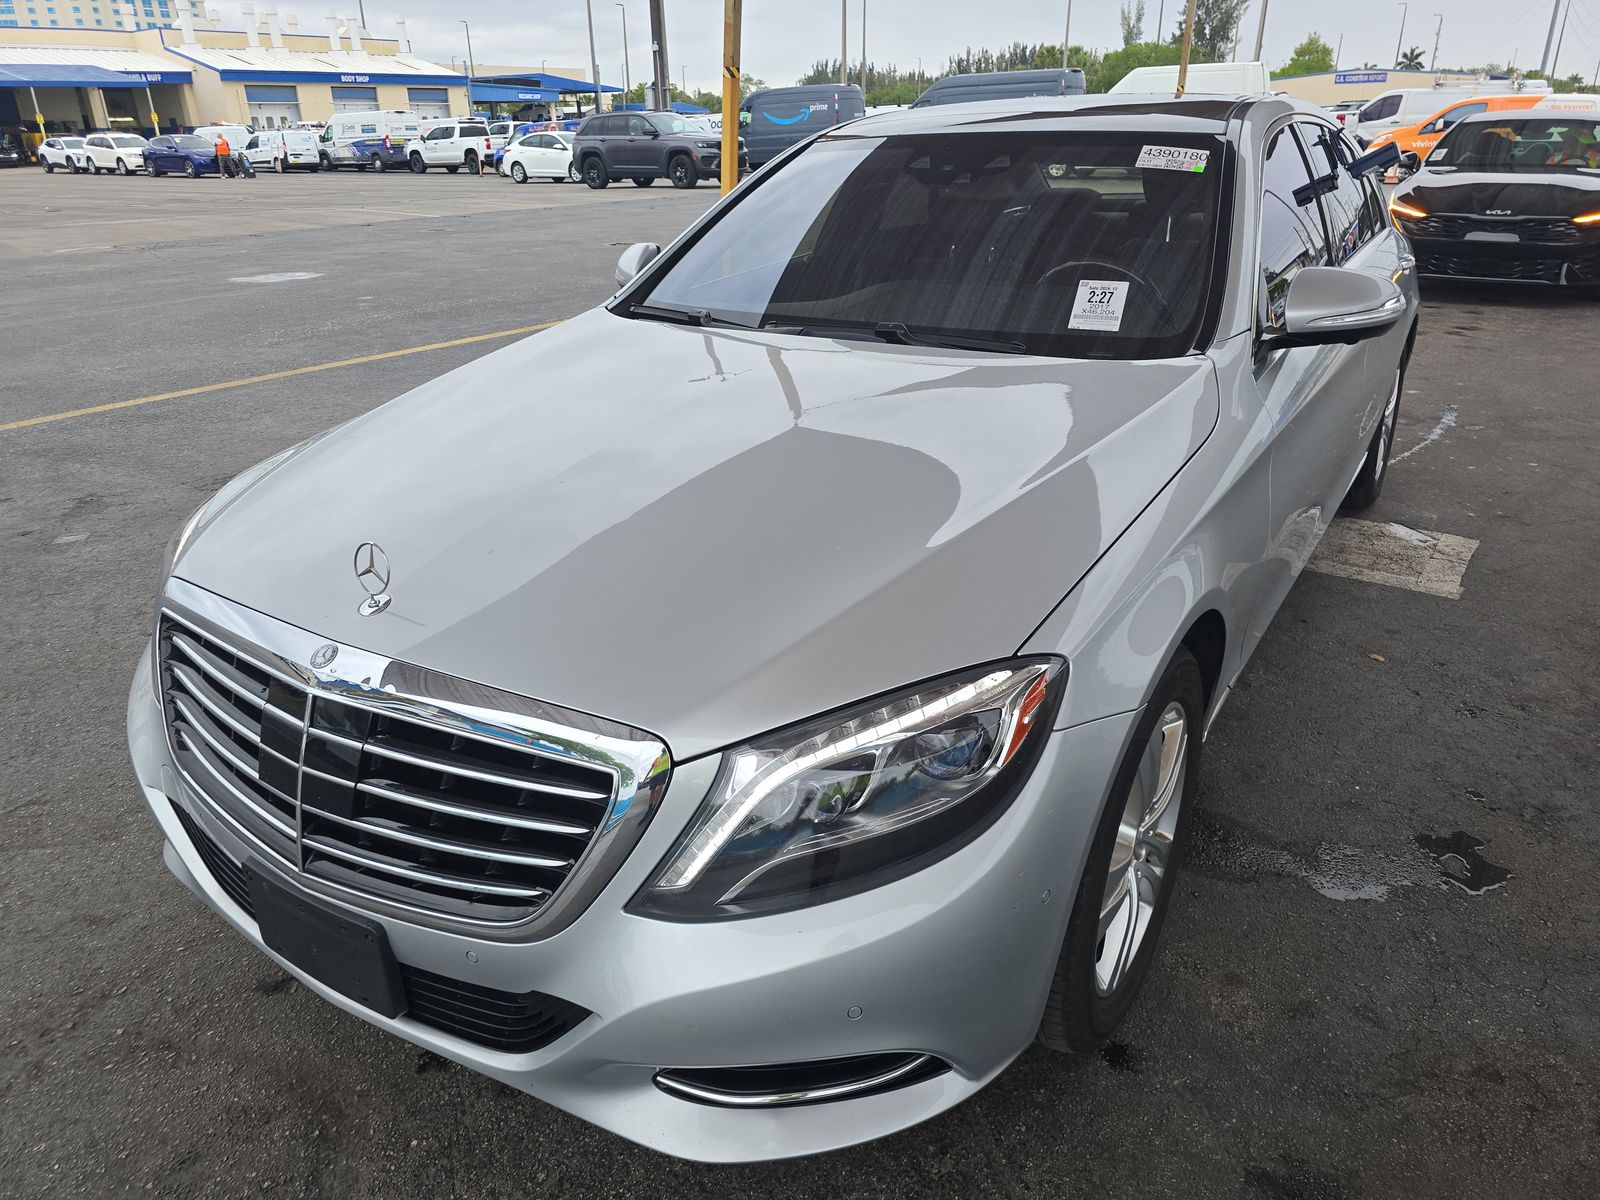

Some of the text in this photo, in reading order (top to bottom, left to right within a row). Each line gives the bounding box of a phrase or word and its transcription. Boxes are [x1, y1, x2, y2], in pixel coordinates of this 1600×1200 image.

[146, 74, 162, 82] BUFF
[355, 75, 369, 83] SHOP
[809, 102, 829, 113] prime
[1143, 148, 1209, 162] 4390180
